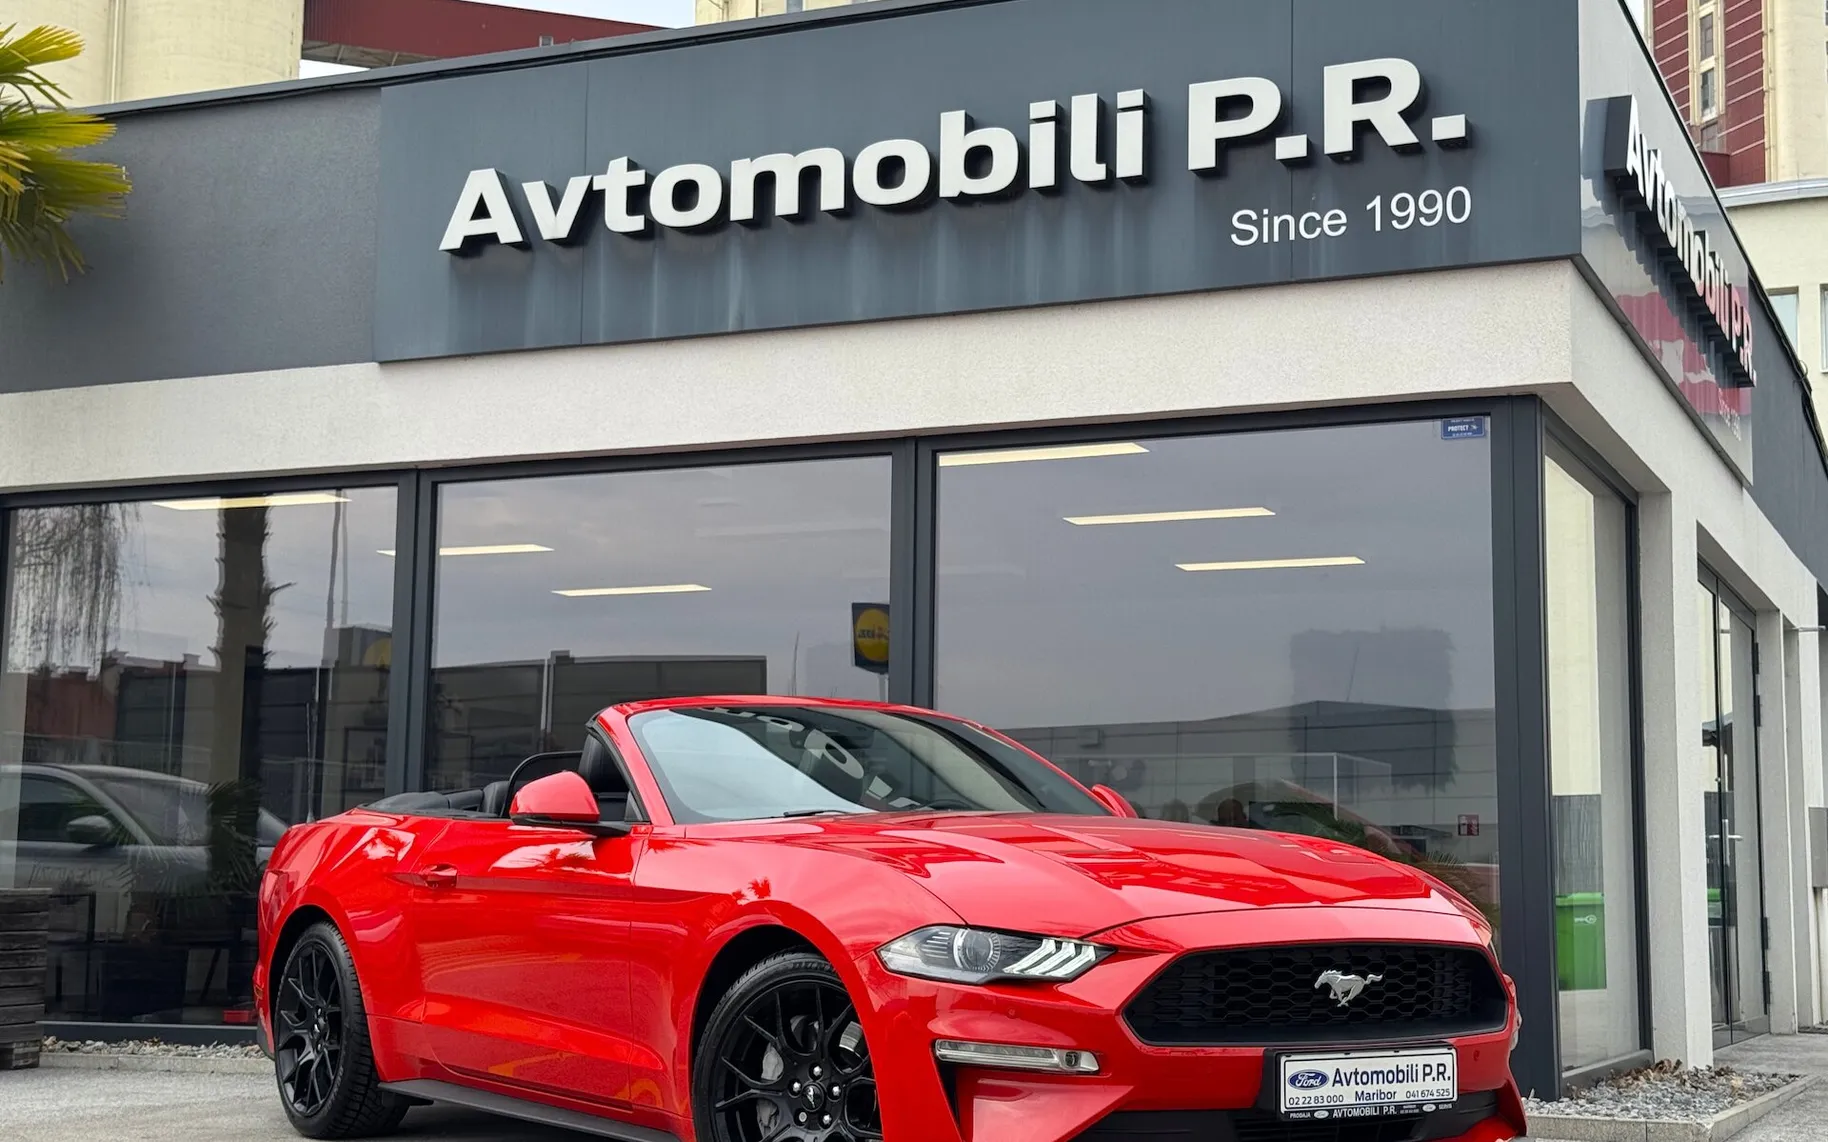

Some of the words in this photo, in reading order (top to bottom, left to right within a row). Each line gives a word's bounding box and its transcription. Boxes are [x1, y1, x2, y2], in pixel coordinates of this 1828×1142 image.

[438, 88, 1145, 252] Avtomobili
[1187, 57, 1468, 172] P.R.
[1230, 207, 1348, 246] Since
[1364, 185, 1472, 233] 1990
[1626, 94, 1731, 341] Avtomobili
[1295, 1072, 1322, 1087] Ford
[1332, 1064, 1418, 1087] Avtomobili
[1422, 1063, 1451, 1082] P.R.
[1288, 1097, 1300, 1106] 02
[1302, 1097, 1313, 1105] 22
[1314, 1096, 1325, 1105] 83
[1326, 1094, 1344, 1104] 000
[1354, 1090, 1397, 1102] Maribor
[1405, 1090, 1420, 1099] 041
[1421, 1089, 1435, 1098] 674
[1436, 1088, 1451, 1097] 525
[1332, 1106, 1380, 1118] AVTOMOBILI
[1382, 1105, 1398, 1115] P.R.
